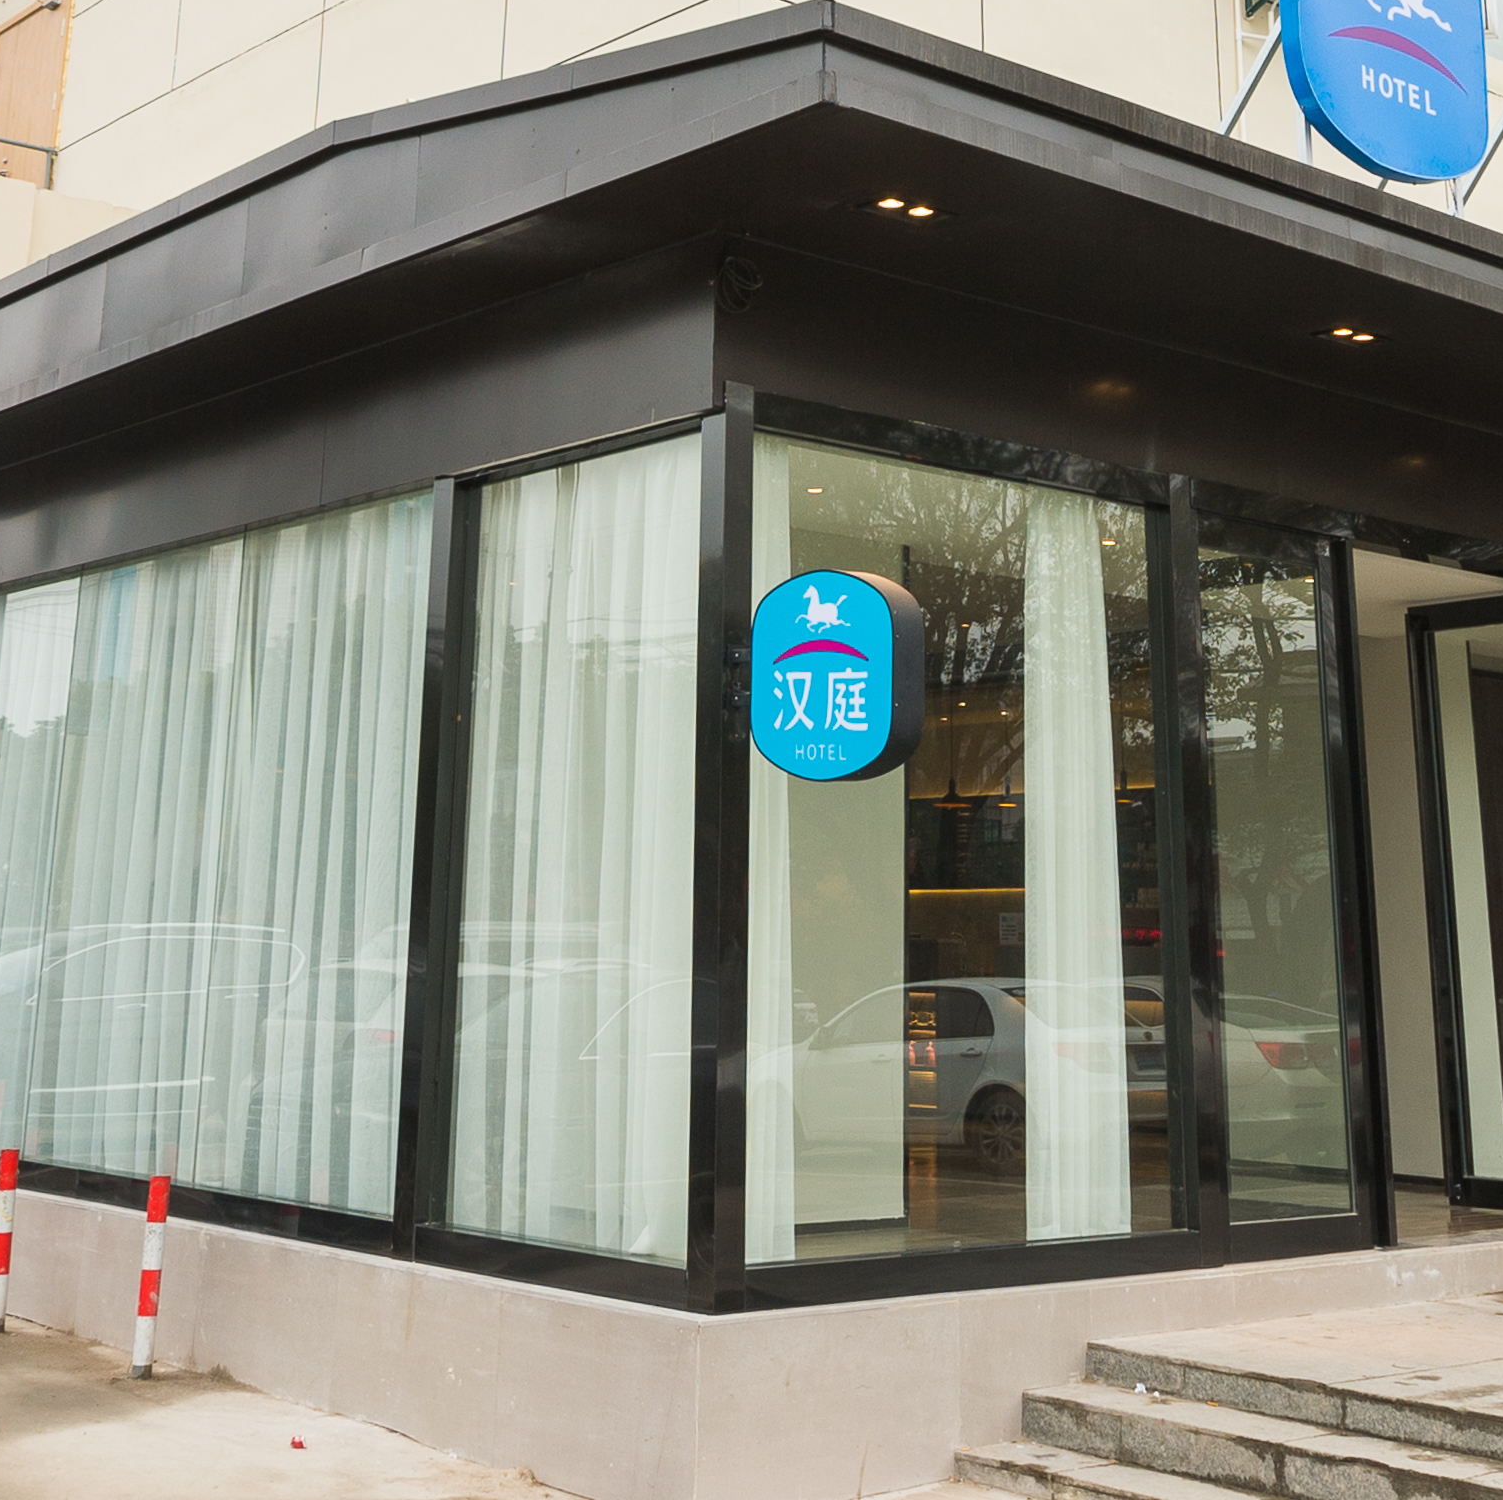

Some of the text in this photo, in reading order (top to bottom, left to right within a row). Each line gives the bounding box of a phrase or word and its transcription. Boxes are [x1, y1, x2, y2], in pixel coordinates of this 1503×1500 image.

[1361, 64, 1438, 116] HOTEL
[773, 667, 869, 732] 汉庭
[795, 743, 847, 761] HOTEL
